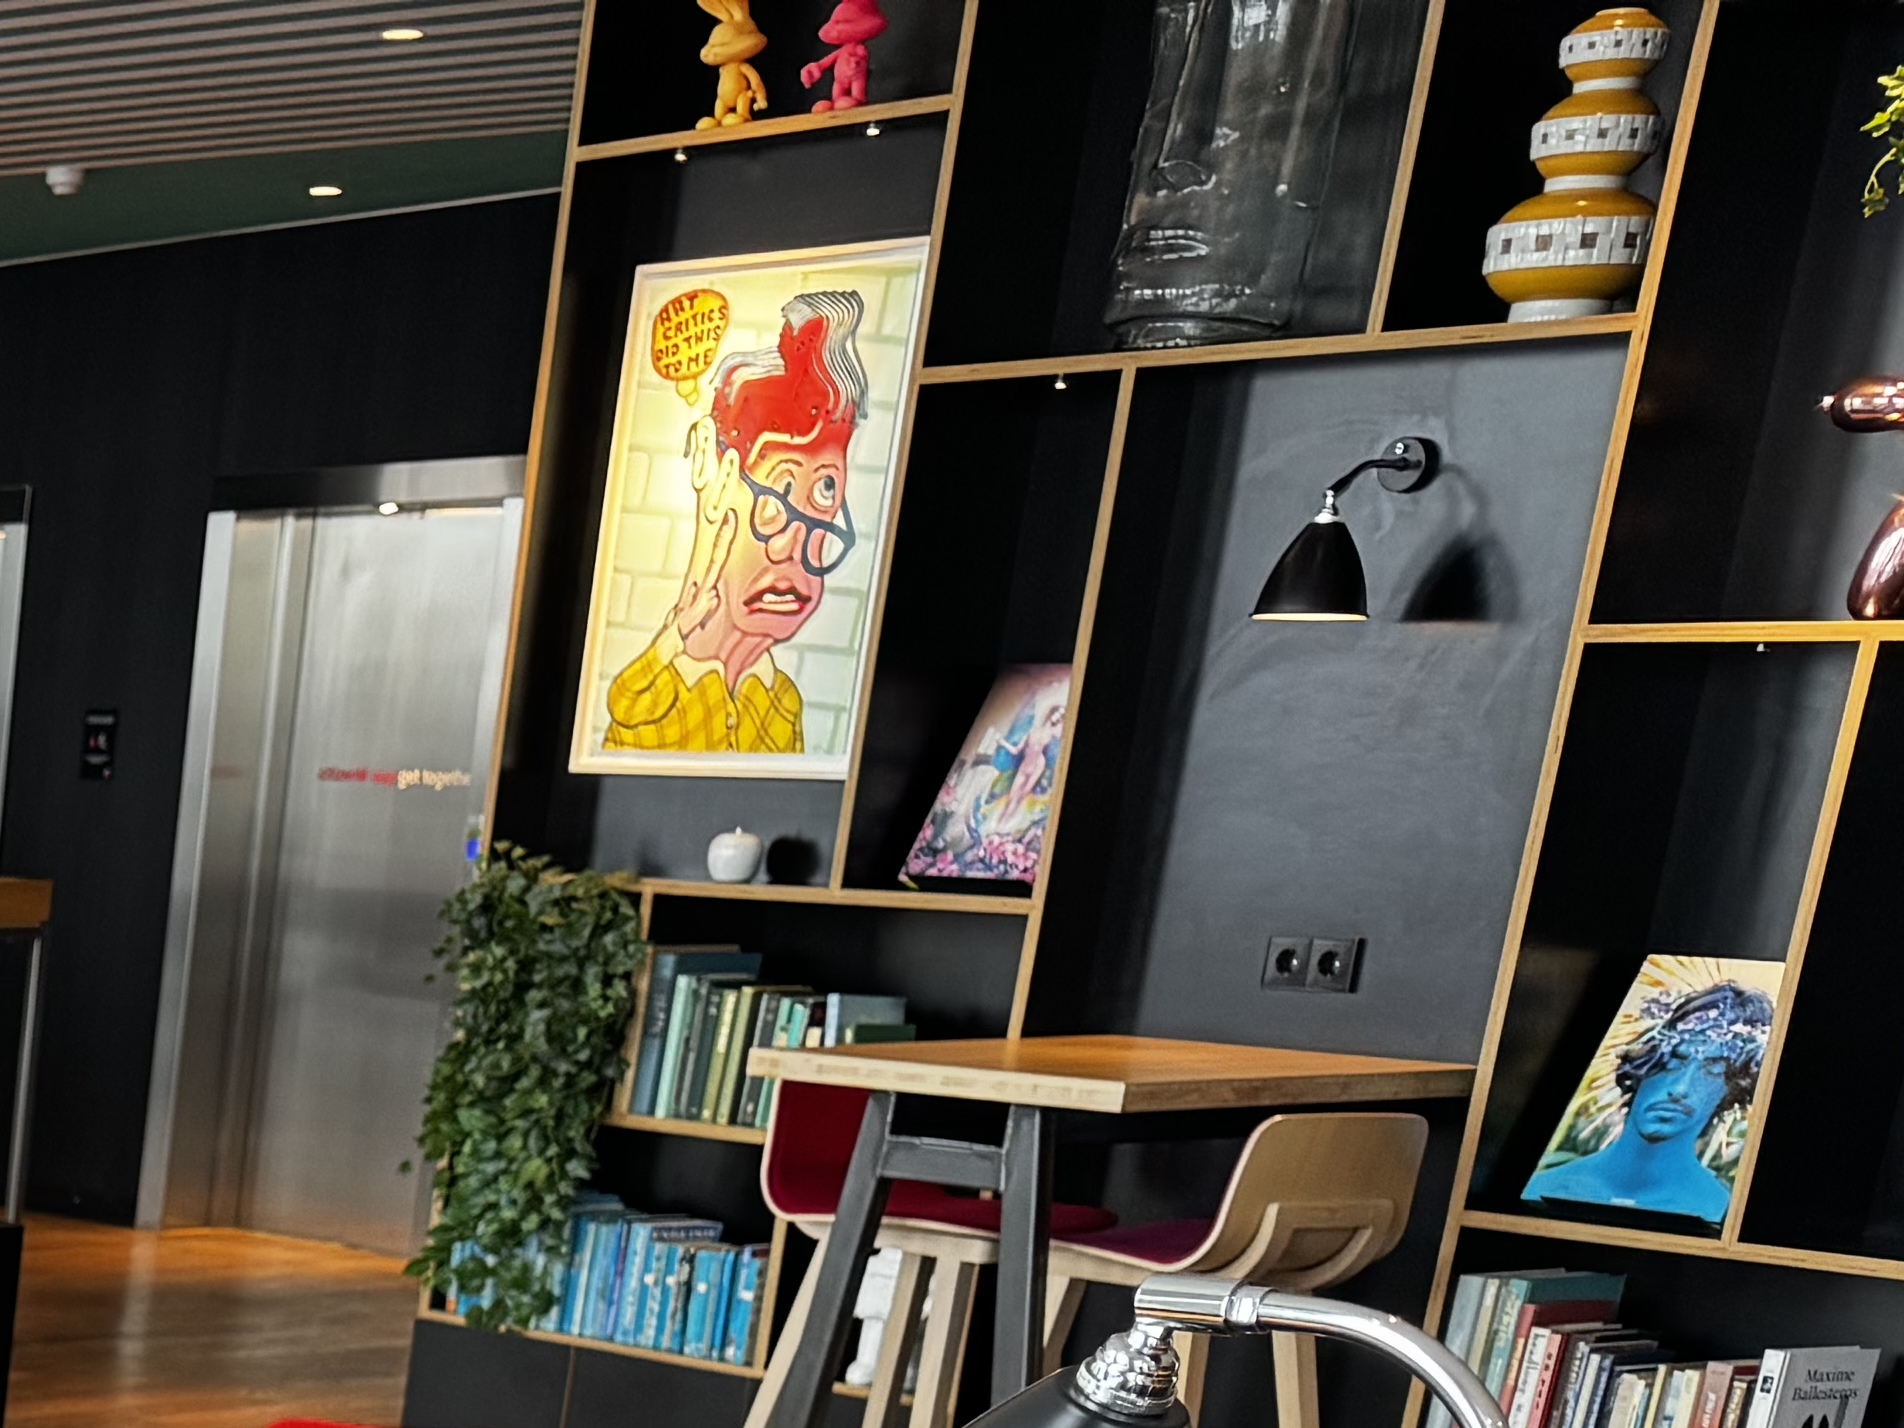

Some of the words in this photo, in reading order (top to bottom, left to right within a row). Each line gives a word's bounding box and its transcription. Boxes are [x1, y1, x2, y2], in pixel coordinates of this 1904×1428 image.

[660, 292, 699, 326] ART
[663, 305, 728, 341] CRITICS
[656, 343, 680, 362] DID
[682, 325, 720, 349] THIS
[663, 360, 682, 377] TO
[687, 348, 713, 371] ME
[1805, 1369, 1855, 1383] Maxime
